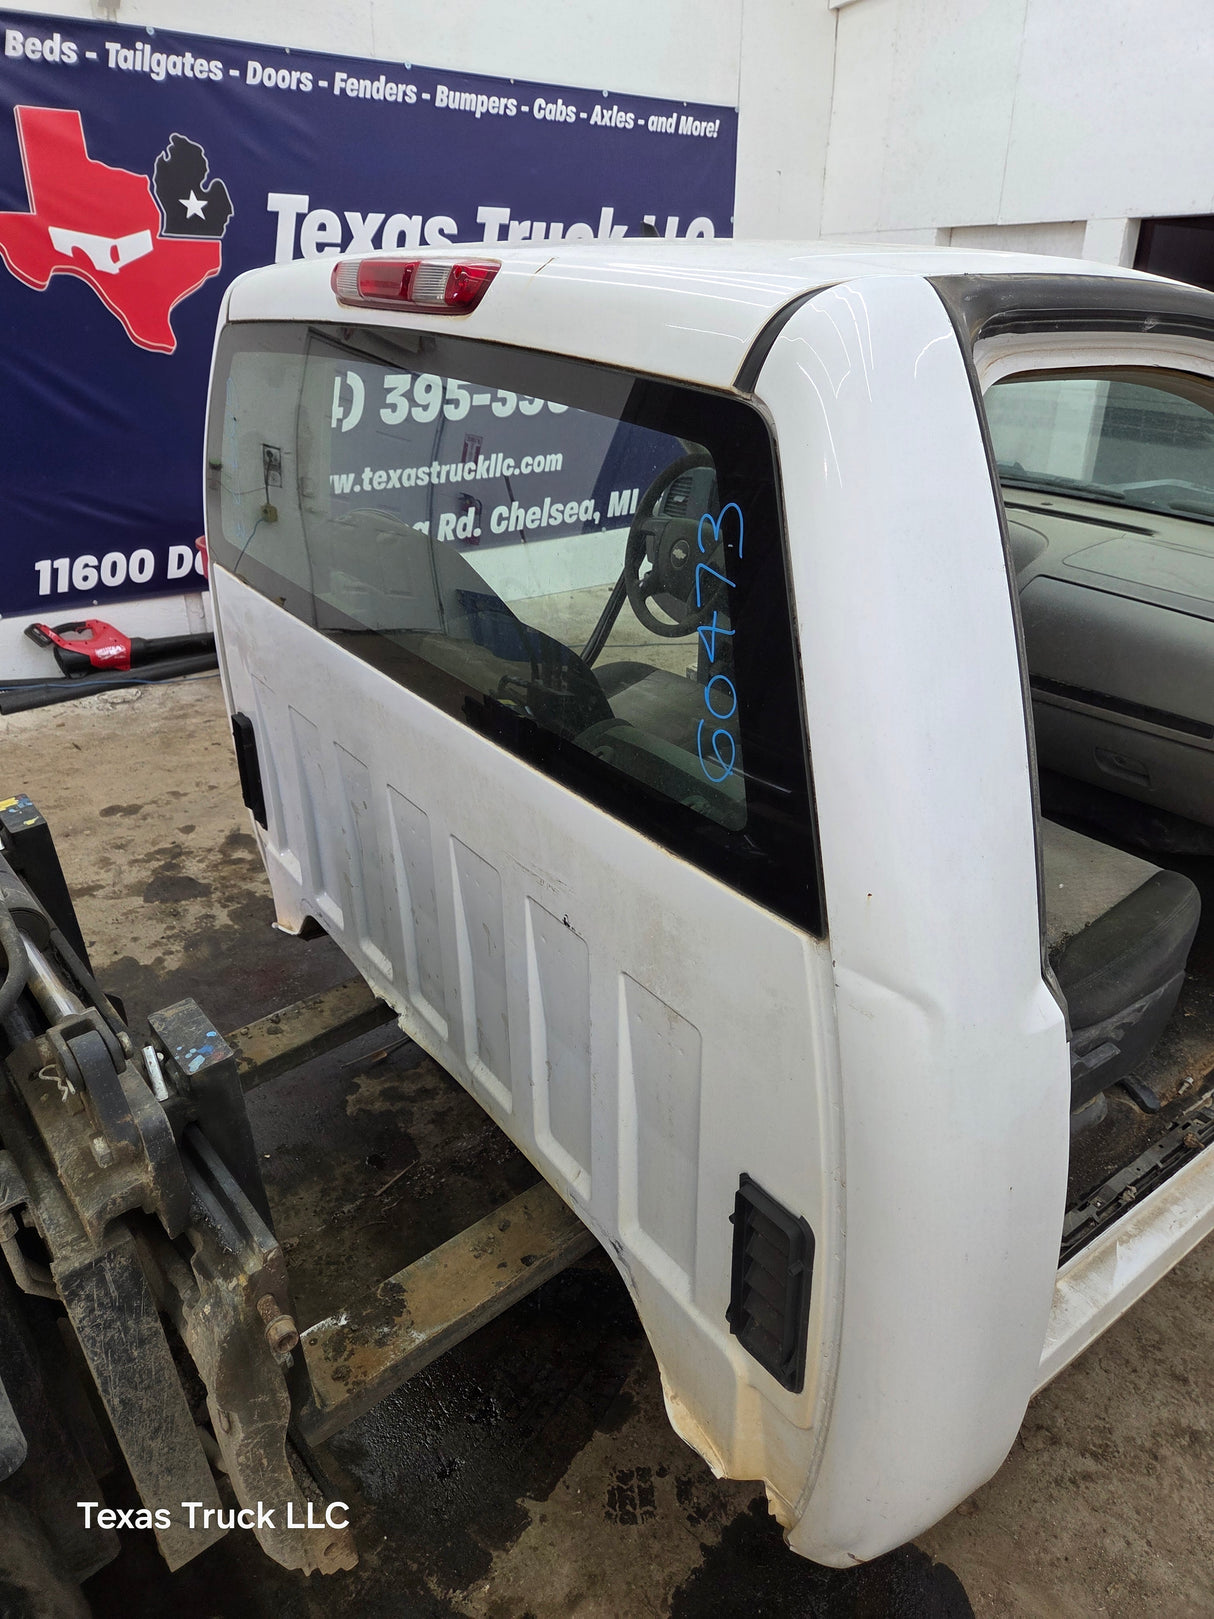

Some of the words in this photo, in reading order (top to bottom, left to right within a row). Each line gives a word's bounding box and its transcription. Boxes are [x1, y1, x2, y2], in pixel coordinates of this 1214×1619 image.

[4, 29, 78, 64] Beds
[105, 41, 224, 82] Tailgates
[246, 60, 313, 93] Doors
[333, 71, 418, 105] Fenders
[435, 85, 518, 118] Bumpers
[533, 98, 577, 123] Cabs
[590, 104, 635, 130] Axles
[647, 113, 677, 134] and
[678, 116, 721, 138] More!
[267, 192, 459, 264] Texas
[379, 373, 588, 425] 395-5
[330, 452, 563, 494] w.texastruckllc.com
[437, 506, 482, 542] Rd.
[489, 497, 600, 535] Chelsea,
[606, 488, 640, 518] MI
[34, 548, 155, 596] 11600
[695, 502, 744, 783] 60473
